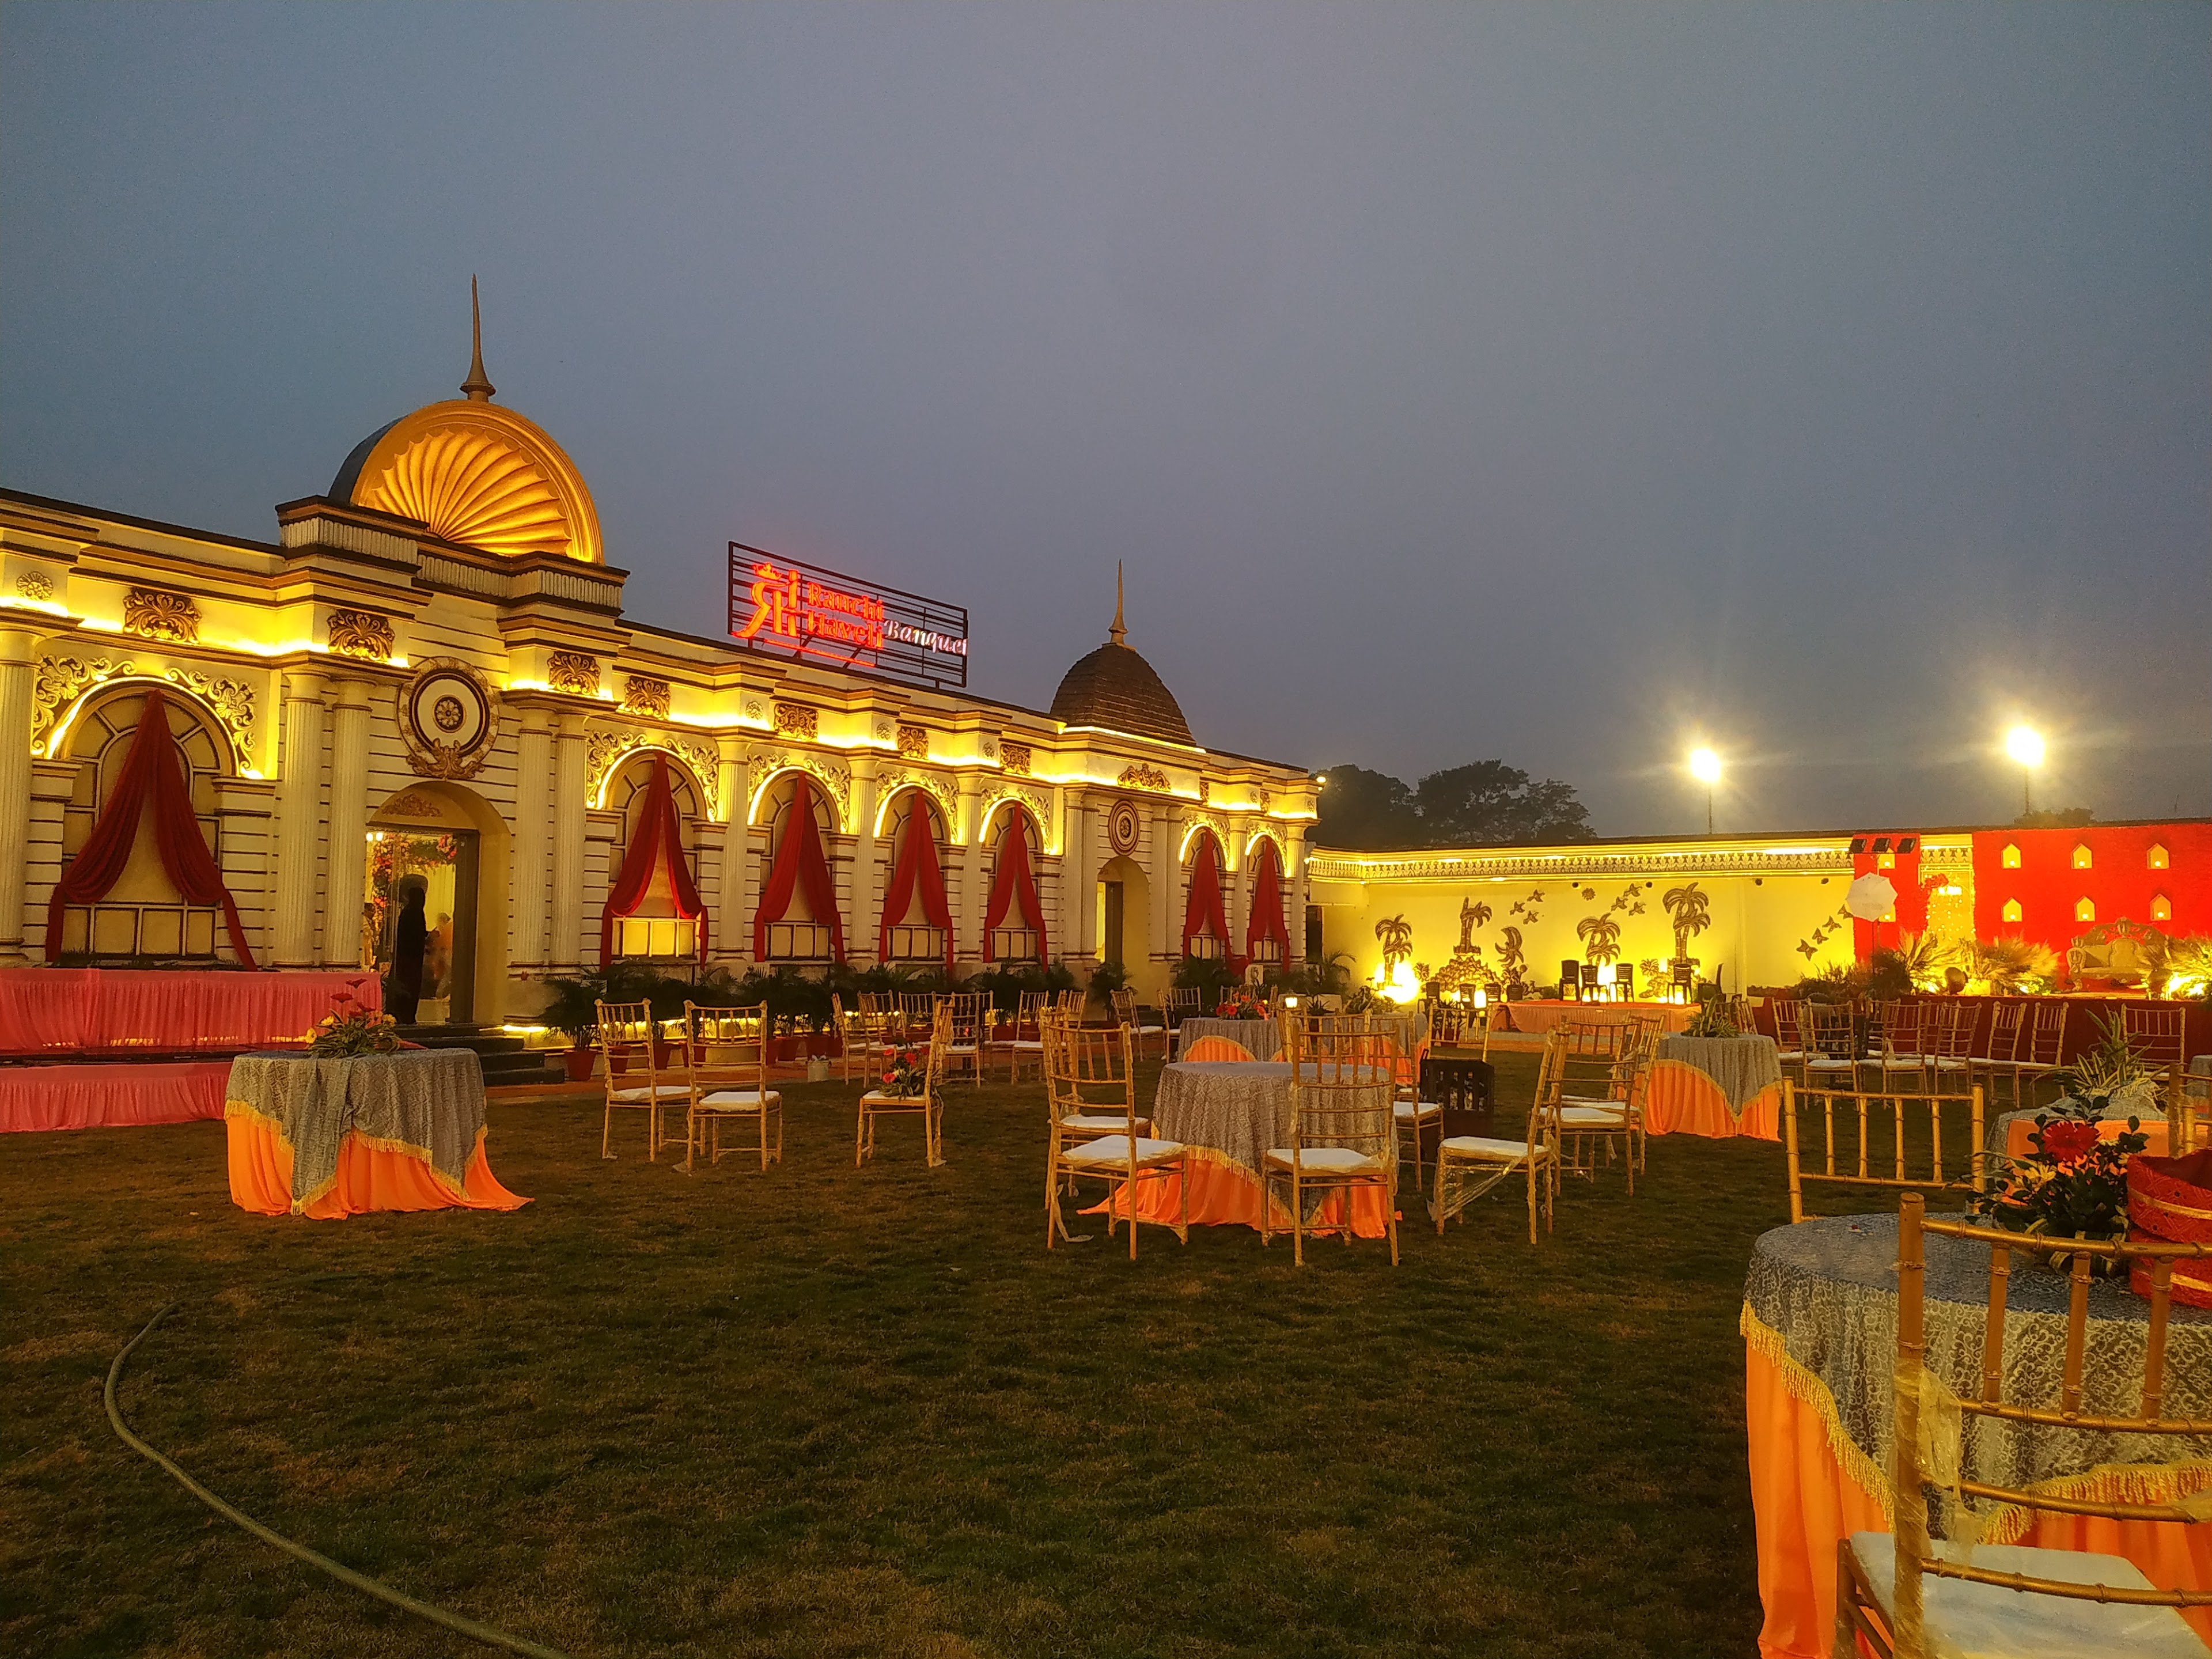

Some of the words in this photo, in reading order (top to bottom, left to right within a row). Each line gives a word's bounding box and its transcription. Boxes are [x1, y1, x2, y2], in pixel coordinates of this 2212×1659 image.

[808, 582, 883, 621] Ranchi
[808, 610, 883, 649] Haveli
[884, 620, 968, 656] Banquet
